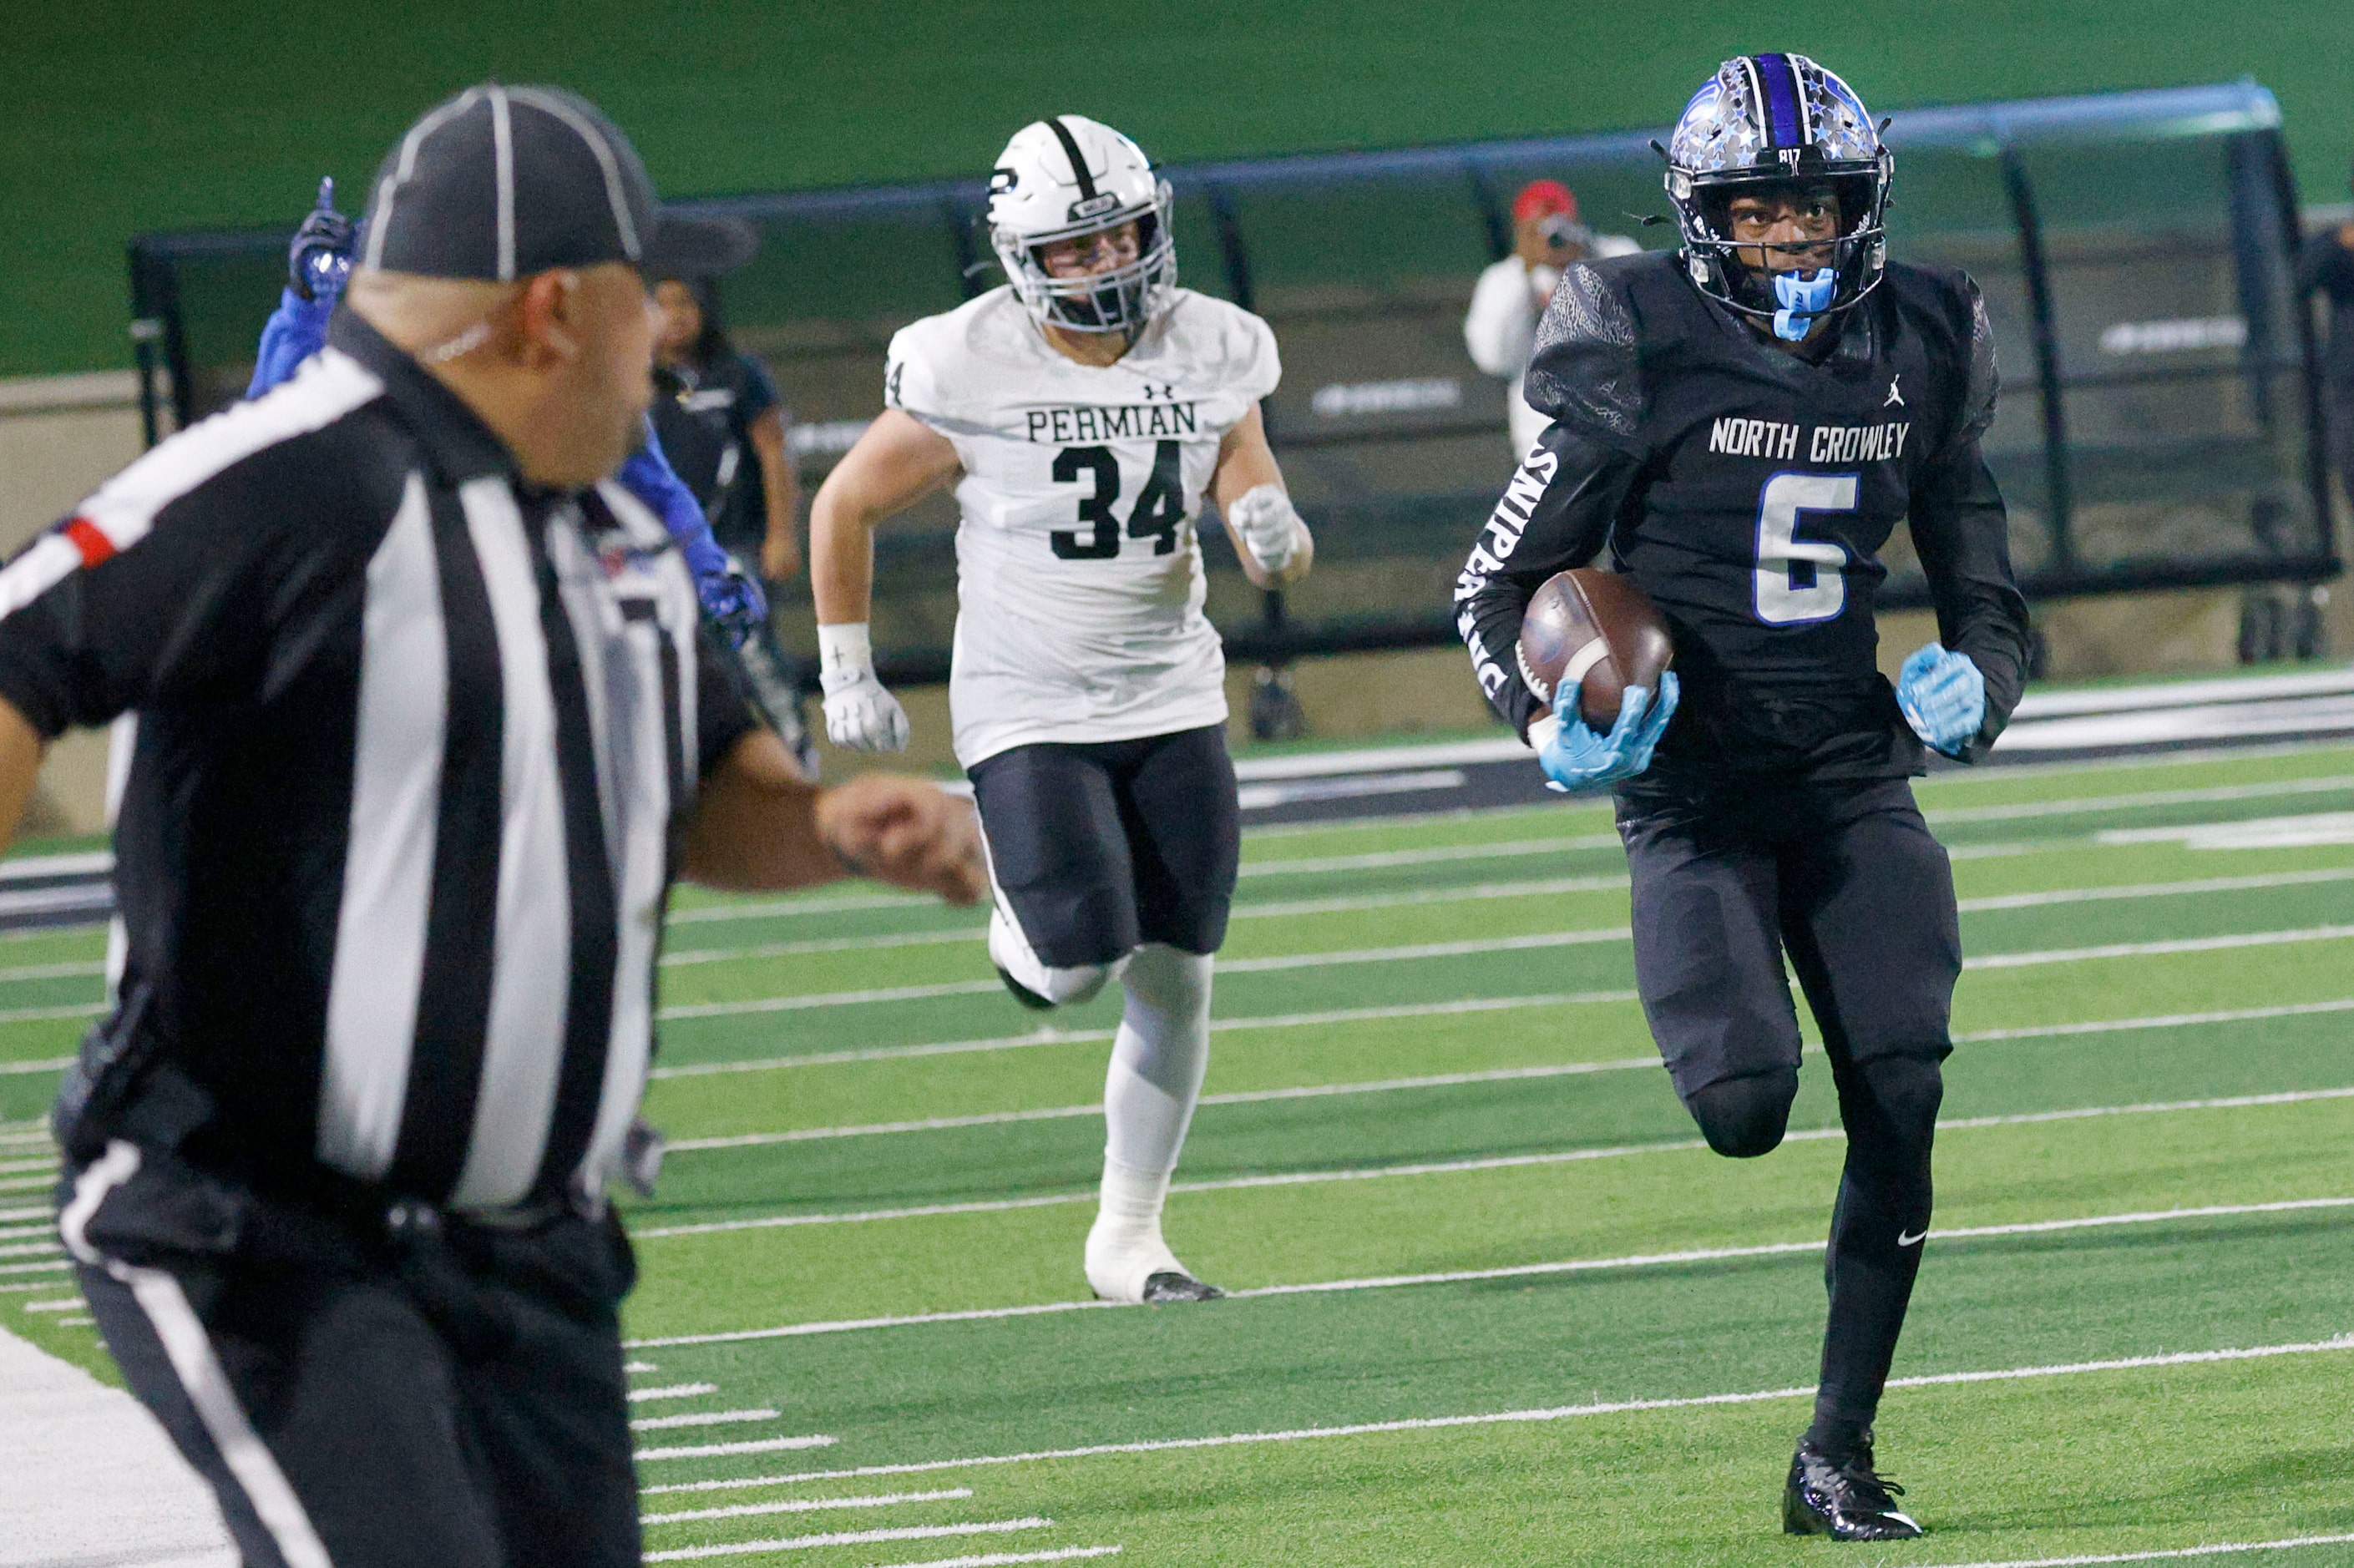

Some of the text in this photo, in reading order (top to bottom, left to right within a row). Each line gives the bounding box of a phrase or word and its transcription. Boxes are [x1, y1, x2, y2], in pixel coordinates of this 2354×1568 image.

[1026, 402, 1196, 443] PERMIAN
[1709, 417, 1911, 464] NORTH CROWLEY
[1050, 439, 1187, 560] 34
[1751, 469, 1862, 628] 6
